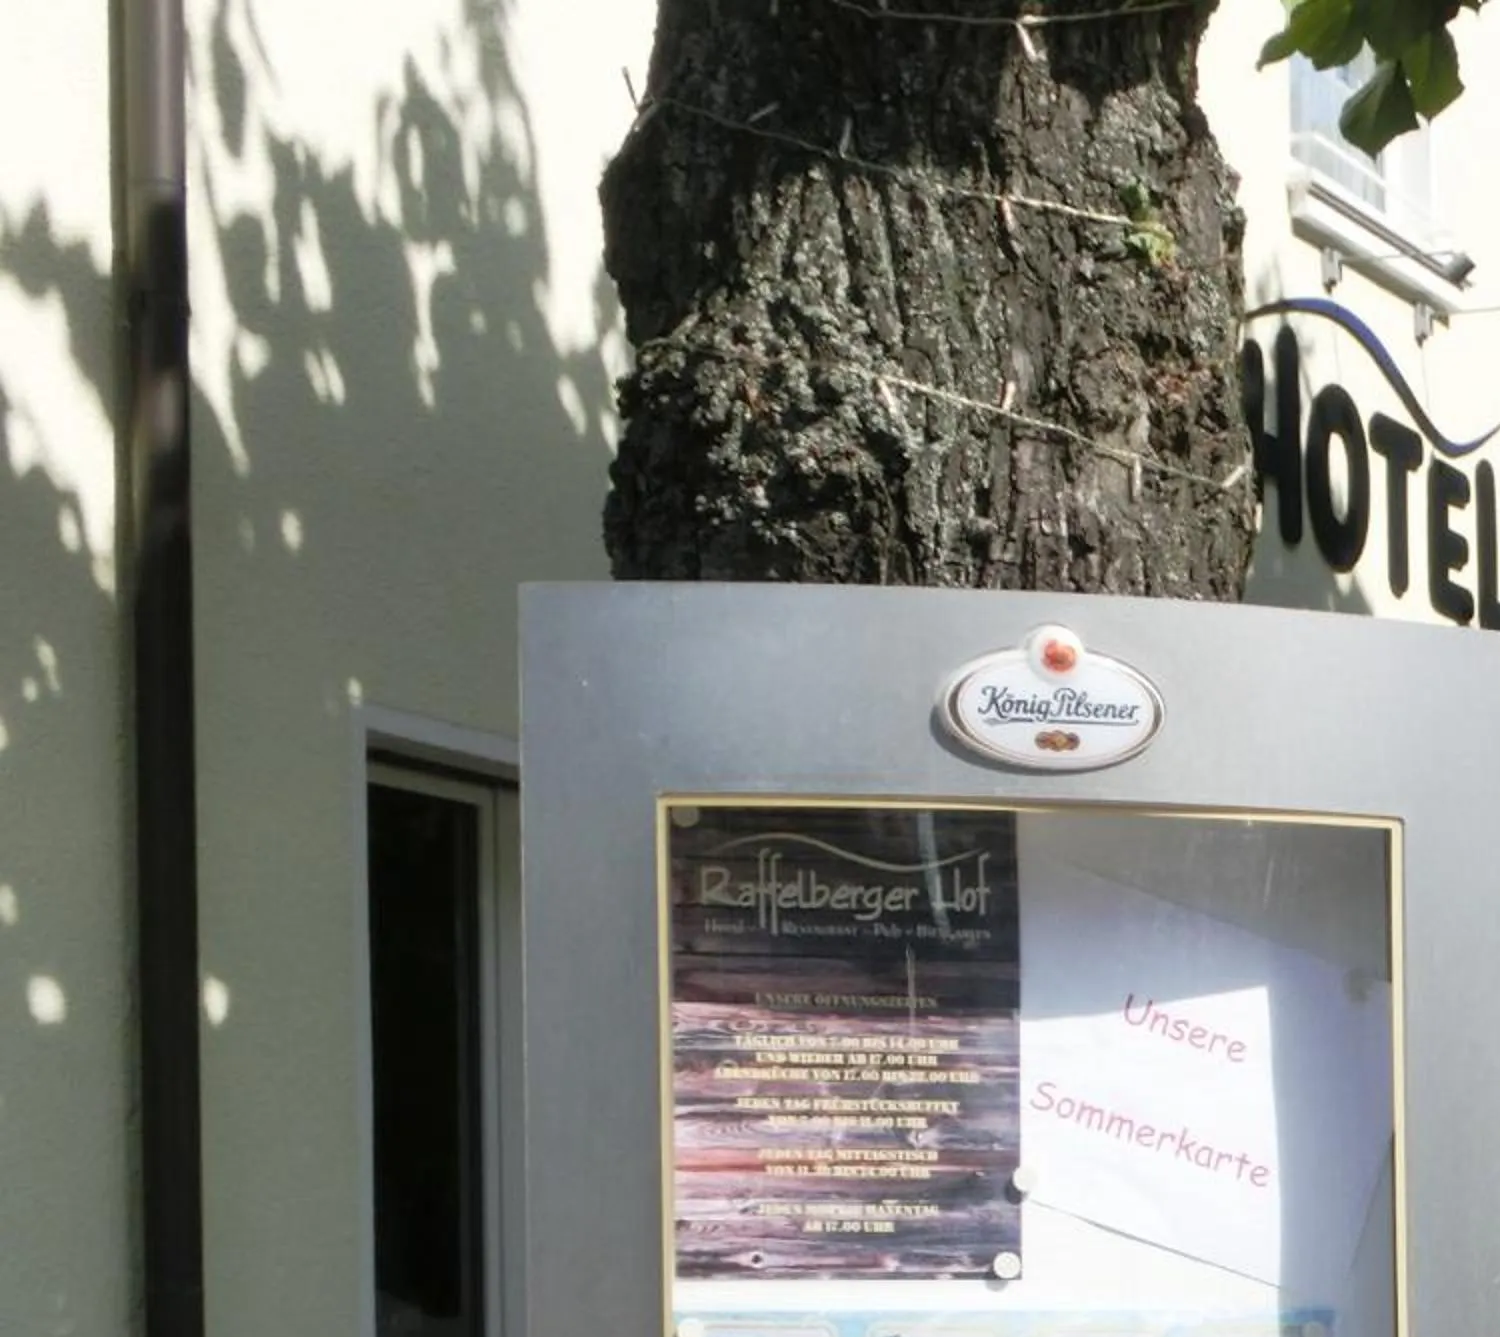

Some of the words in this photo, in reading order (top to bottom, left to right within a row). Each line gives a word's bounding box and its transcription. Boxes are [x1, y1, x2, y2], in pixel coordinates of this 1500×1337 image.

[978, 685, 1050, 722] König
[1051, 687, 1141, 720] Pilsener
[700, 847, 919, 937] Raffelberger
[931, 852, 992, 916] Hof
[1123, 993, 1247, 1063] Unsere
[1030, 1081, 1270, 1188] Sommerkarte
